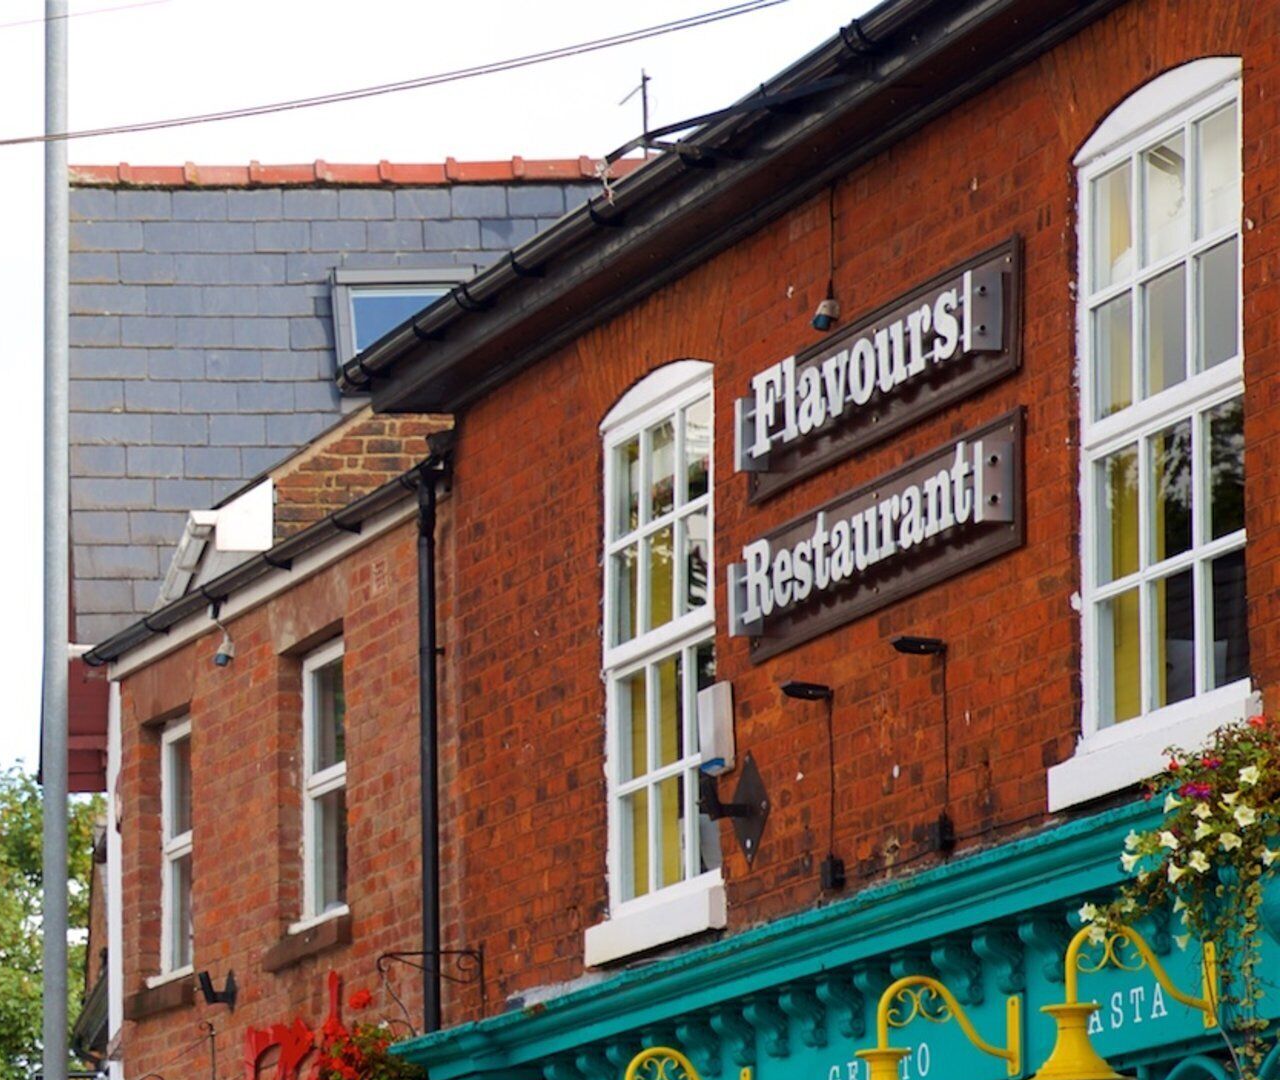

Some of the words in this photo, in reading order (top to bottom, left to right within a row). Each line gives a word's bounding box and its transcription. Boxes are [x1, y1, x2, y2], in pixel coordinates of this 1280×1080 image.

[751, 287, 960, 459] Flavours
[742, 441, 974, 625] Restaurant
[1088, 982, 1168, 1035] ASTA
